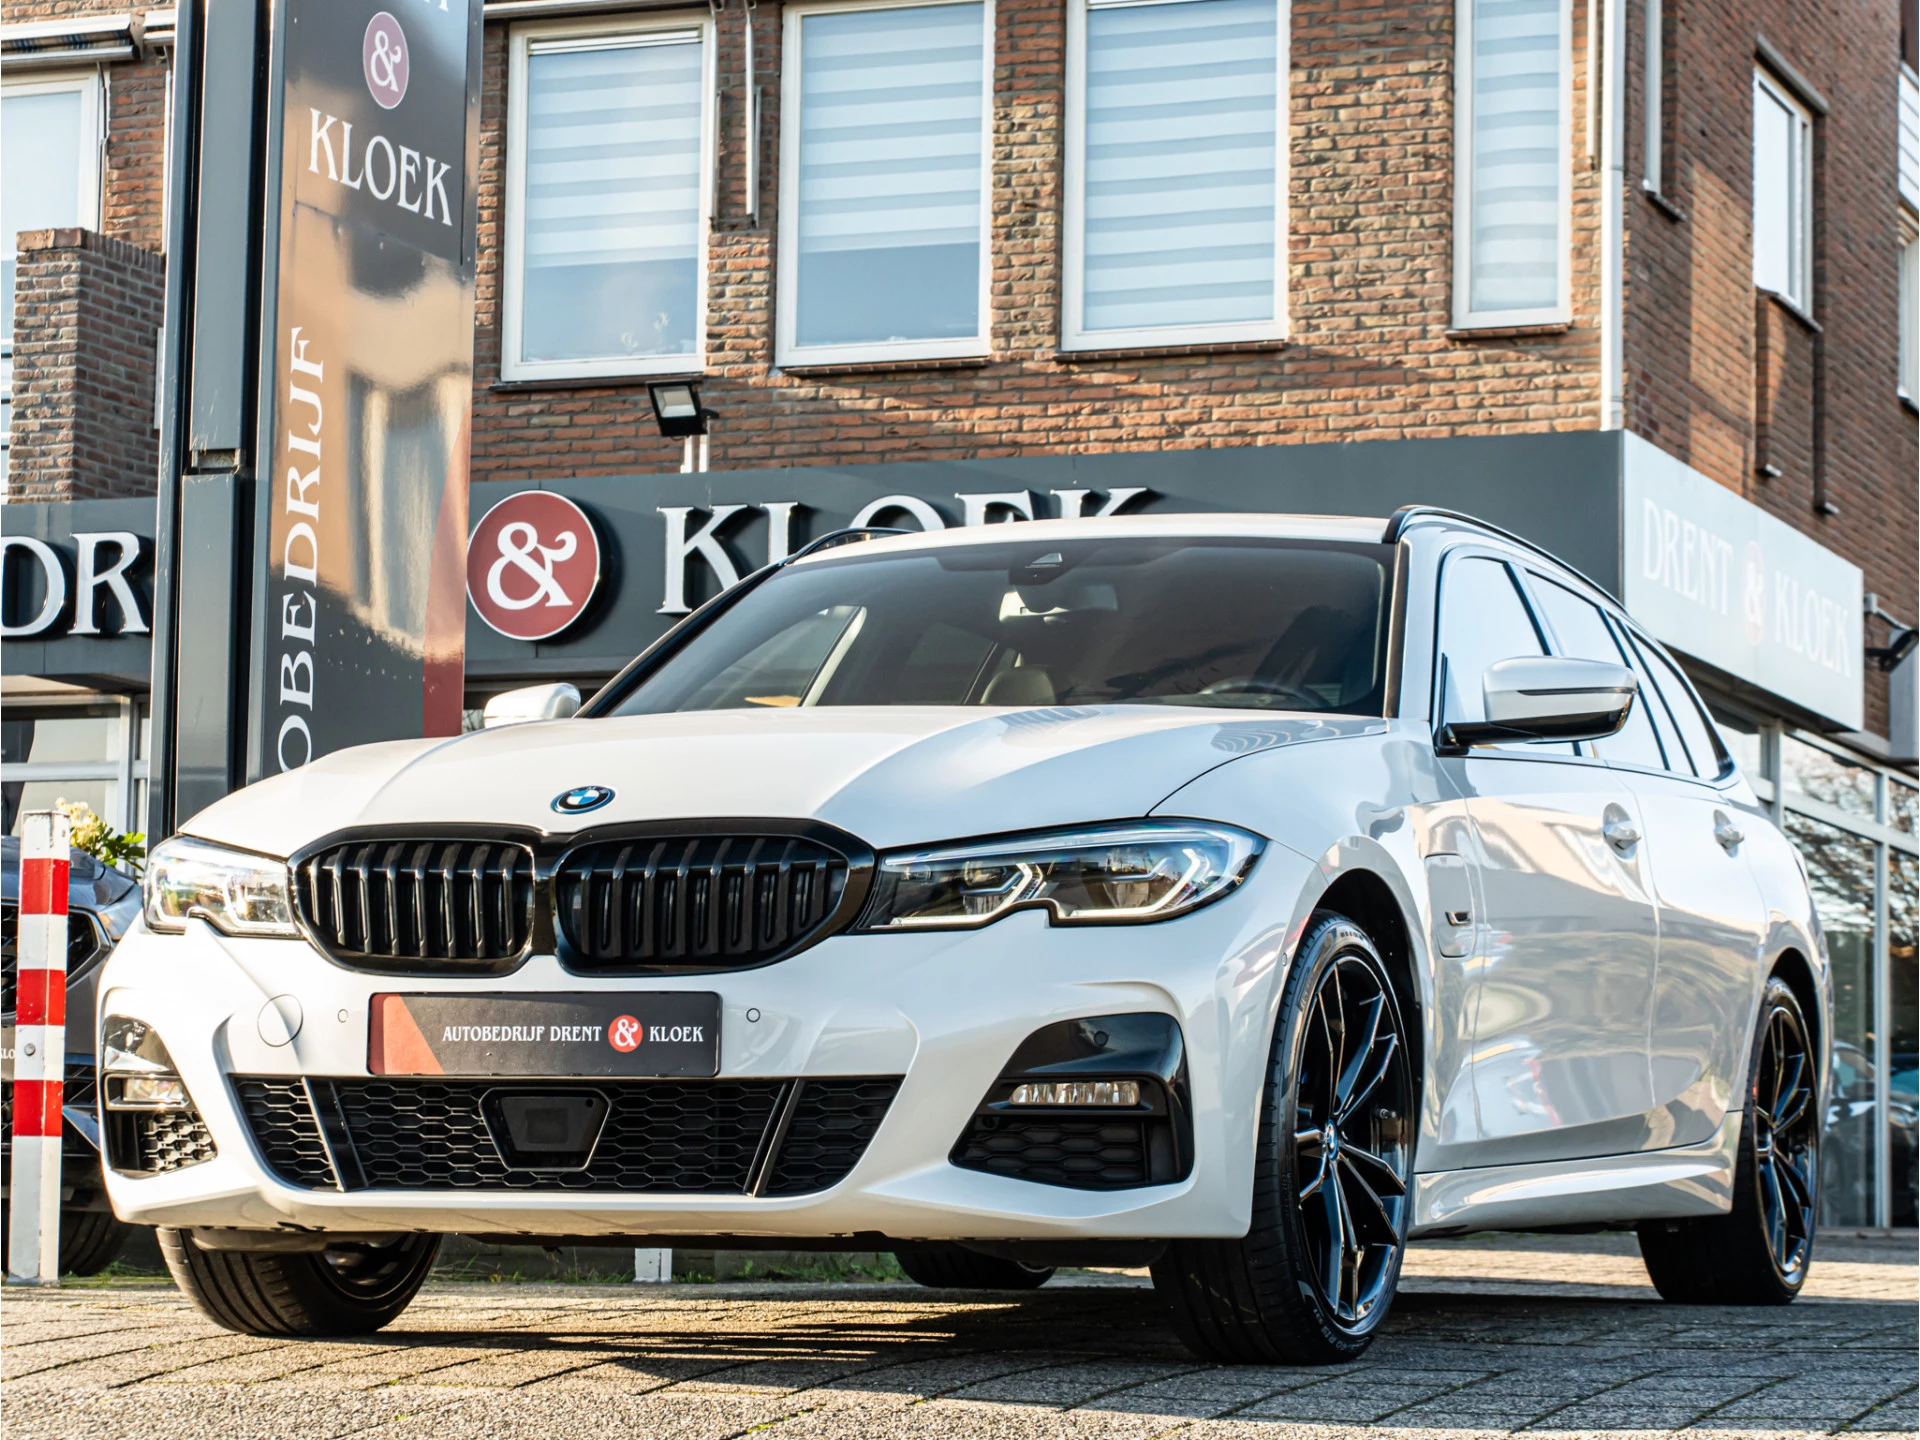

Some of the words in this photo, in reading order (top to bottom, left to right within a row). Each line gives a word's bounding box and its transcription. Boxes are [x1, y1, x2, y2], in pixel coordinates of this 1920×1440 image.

[371, 30, 402, 92] &
[308, 107, 453, 227] KLOEK
[0, 531, 150, 637] DR
[487, 521, 577, 610] &
[277, 326, 324, 773] OBEDRIJF
[1642, 497, 1734, 616] DRENT
[1743, 561, 1764, 627] &
[1774, 569, 1852, 678] KLOEK
[442, 1025, 545, 1043] AUTOBEDRIJF
[550, 1025, 602, 1042] DRENT
[614, 1019, 638, 1047] &
[649, 1026, 704, 1043] KLOEK
